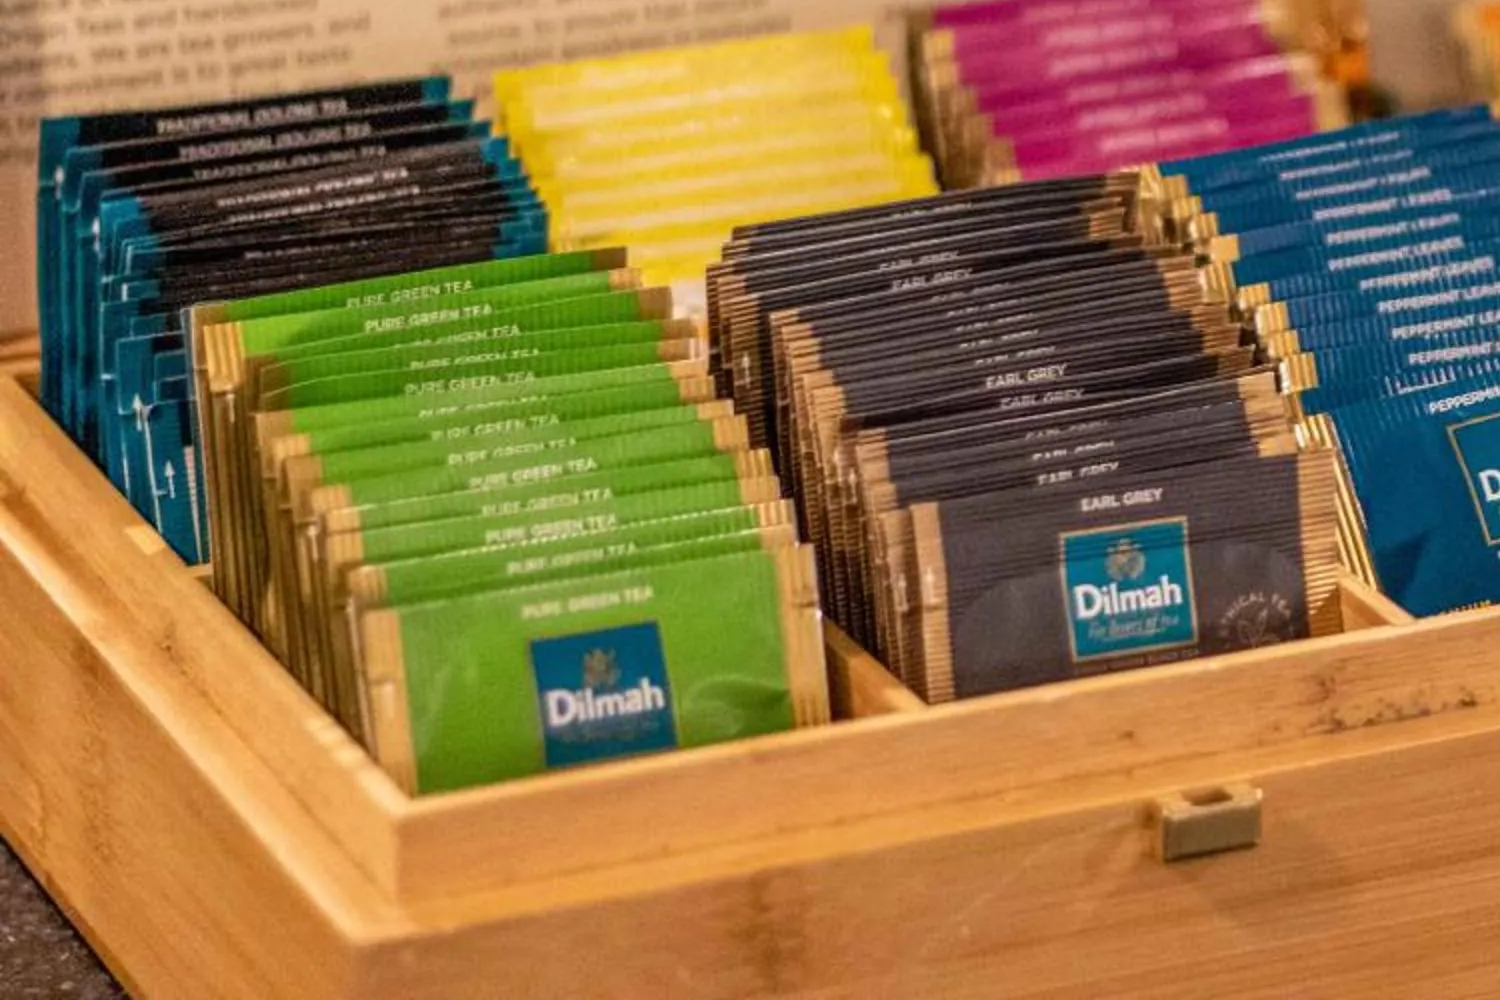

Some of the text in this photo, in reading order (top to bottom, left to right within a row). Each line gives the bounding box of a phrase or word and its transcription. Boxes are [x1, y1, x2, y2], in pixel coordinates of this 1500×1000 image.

[390, 284, 441, 304] GREEN
[445, 279, 474, 295] TEA
[1378, 288, 1460, 313] PEPPERMINT
[364, 302, 493, 335] PURE GREEN TEA
[489, 322, 522, 339] TEA
[1392, 313, 1476, 341] PEPPERMINT
[1407, 339, 1492, 366] PEPPERMINT
[506, 370, 537, 386] TEA
[986, 362, 1068, 390] EARL GREY
[510, 462, 564, 484] GREEN
[566, 456, 599, 474] TEA
[1080, 487, 1163, 513] EARL GREY
[585, 512, 617, 531] TEA
[520, 584, 655, 620] PURE GREEN TEA
[1072, 573, 1184, 620] Dilmah
[546, 676, 666, 727] Dilmah
